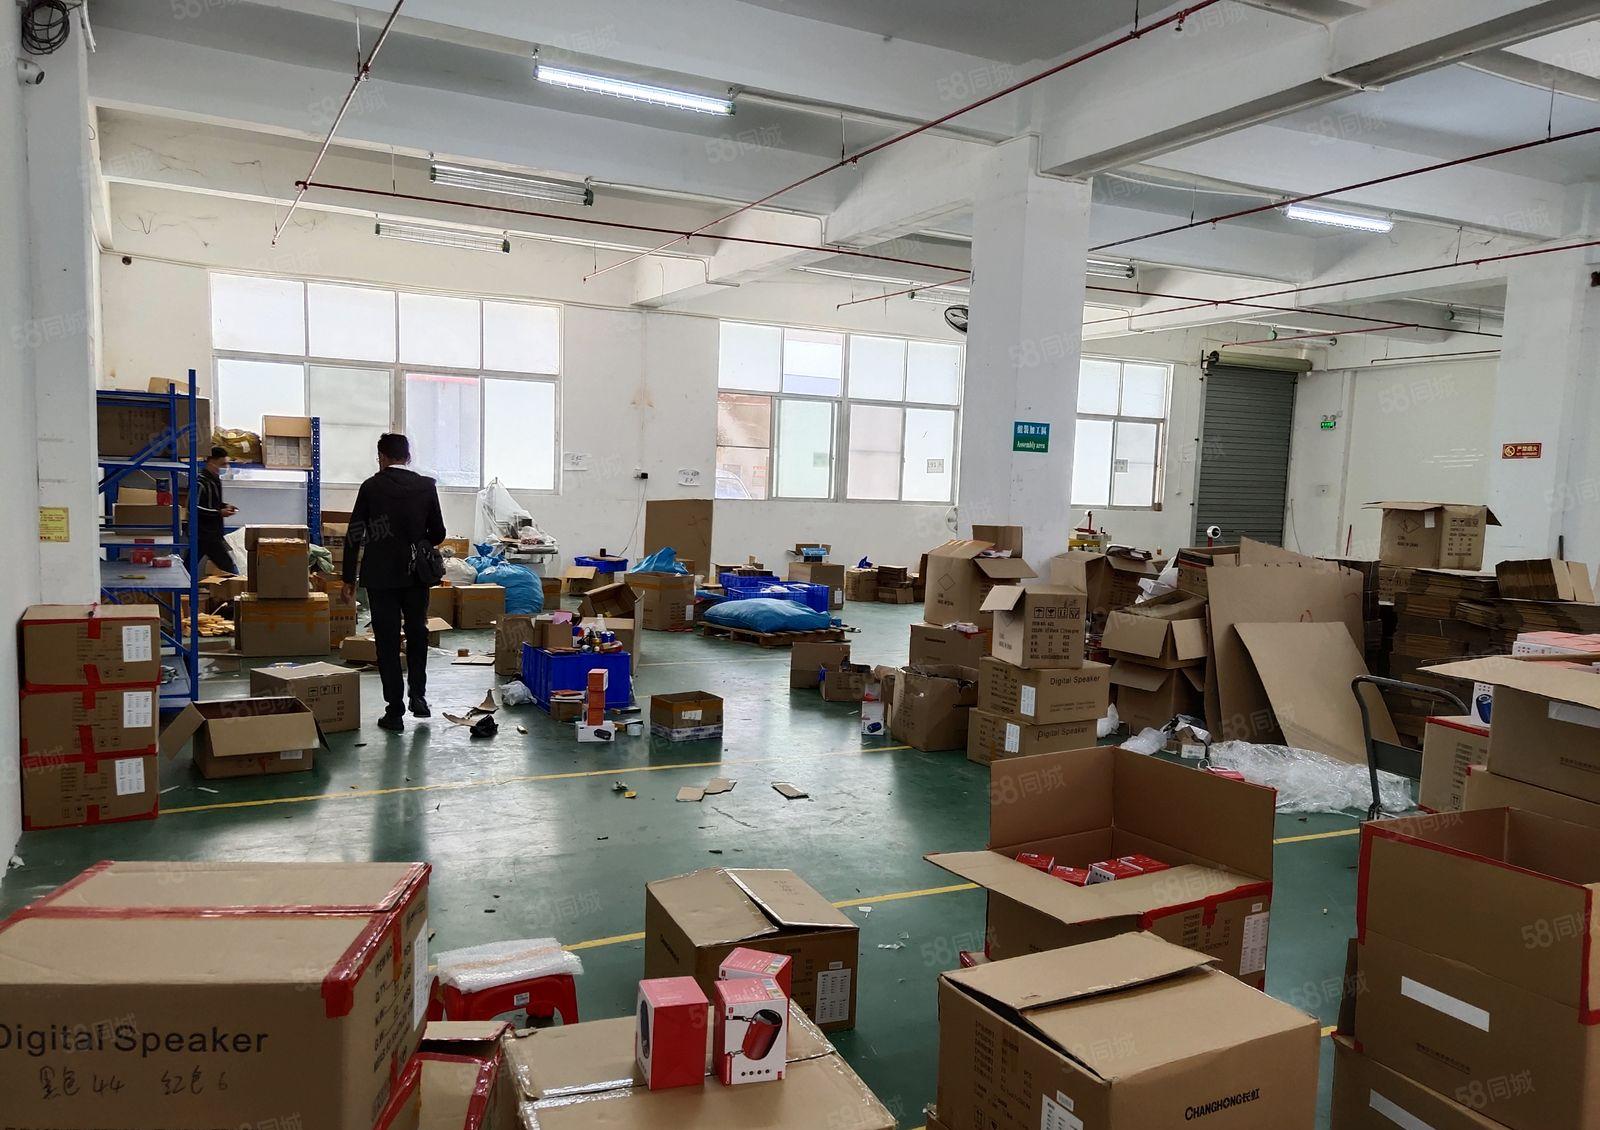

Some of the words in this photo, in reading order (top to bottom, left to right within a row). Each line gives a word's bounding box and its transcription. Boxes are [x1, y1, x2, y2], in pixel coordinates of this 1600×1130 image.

[1016, 440, 1035, 450] Assembly
[1050, 676, 1072, 687] Digital
[1073, 675, 1100, 684] Speaker
[1062, 727, 1087, 735] Speaker
[0, 1023, 104, 1057] Digital
[114, 1024, 269, 1057] Speaker
[161, 1065, 203, 1096] 红色
[218, 1071, 229, 1091] 6
